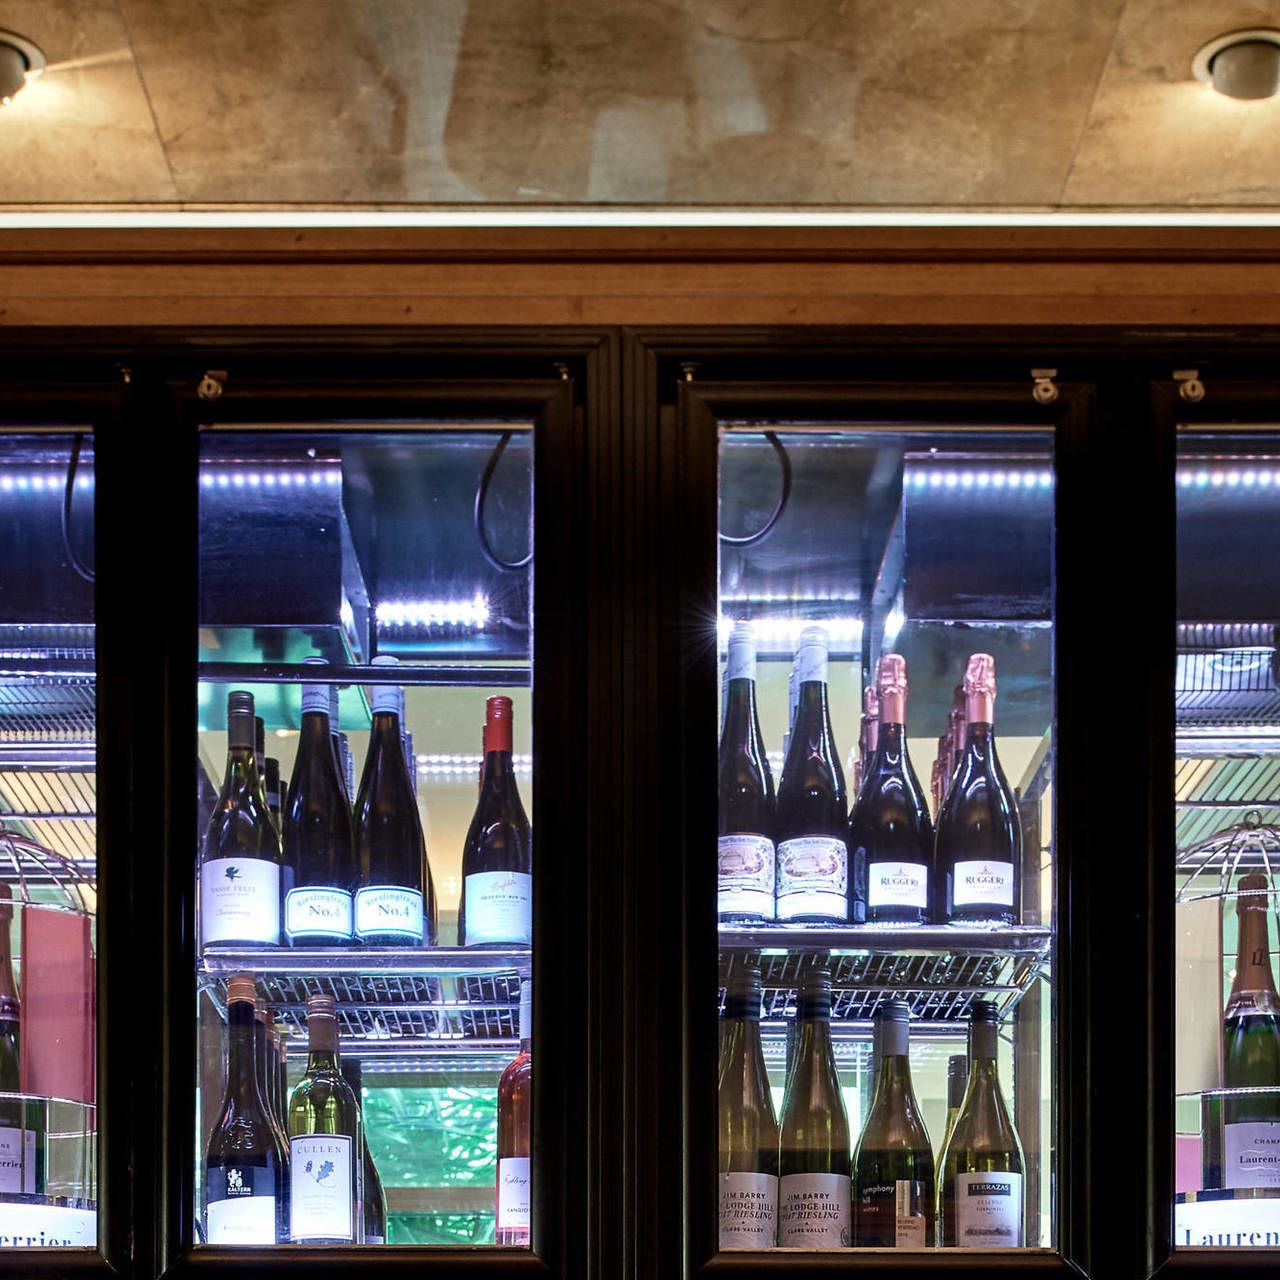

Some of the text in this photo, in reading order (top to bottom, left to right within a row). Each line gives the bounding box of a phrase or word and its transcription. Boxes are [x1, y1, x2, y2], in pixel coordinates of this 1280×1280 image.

[881, 877, 919, 888] RUGGERI
[965, 875, 1005, 886] RUGGERI
[378, 903, 409, 918] No.4
[296, 1144, 342, 1155] CULLEN
[970, 1182, 1010, 1192] TERRAZAS
[723, 1192, 767, 1201] JIM BARRY
[788, 1192, 830, 1202] JIM BARRY
[726, 1201, 755, 1211] LODGE
[790, 1202, 841, 1212] LODGE HILL
[734, 1210, 773, 1221] RIESLING
[797, 1211, 839, 1221] RIESLING
[743, 1226, 765, 1234] VALLEY
